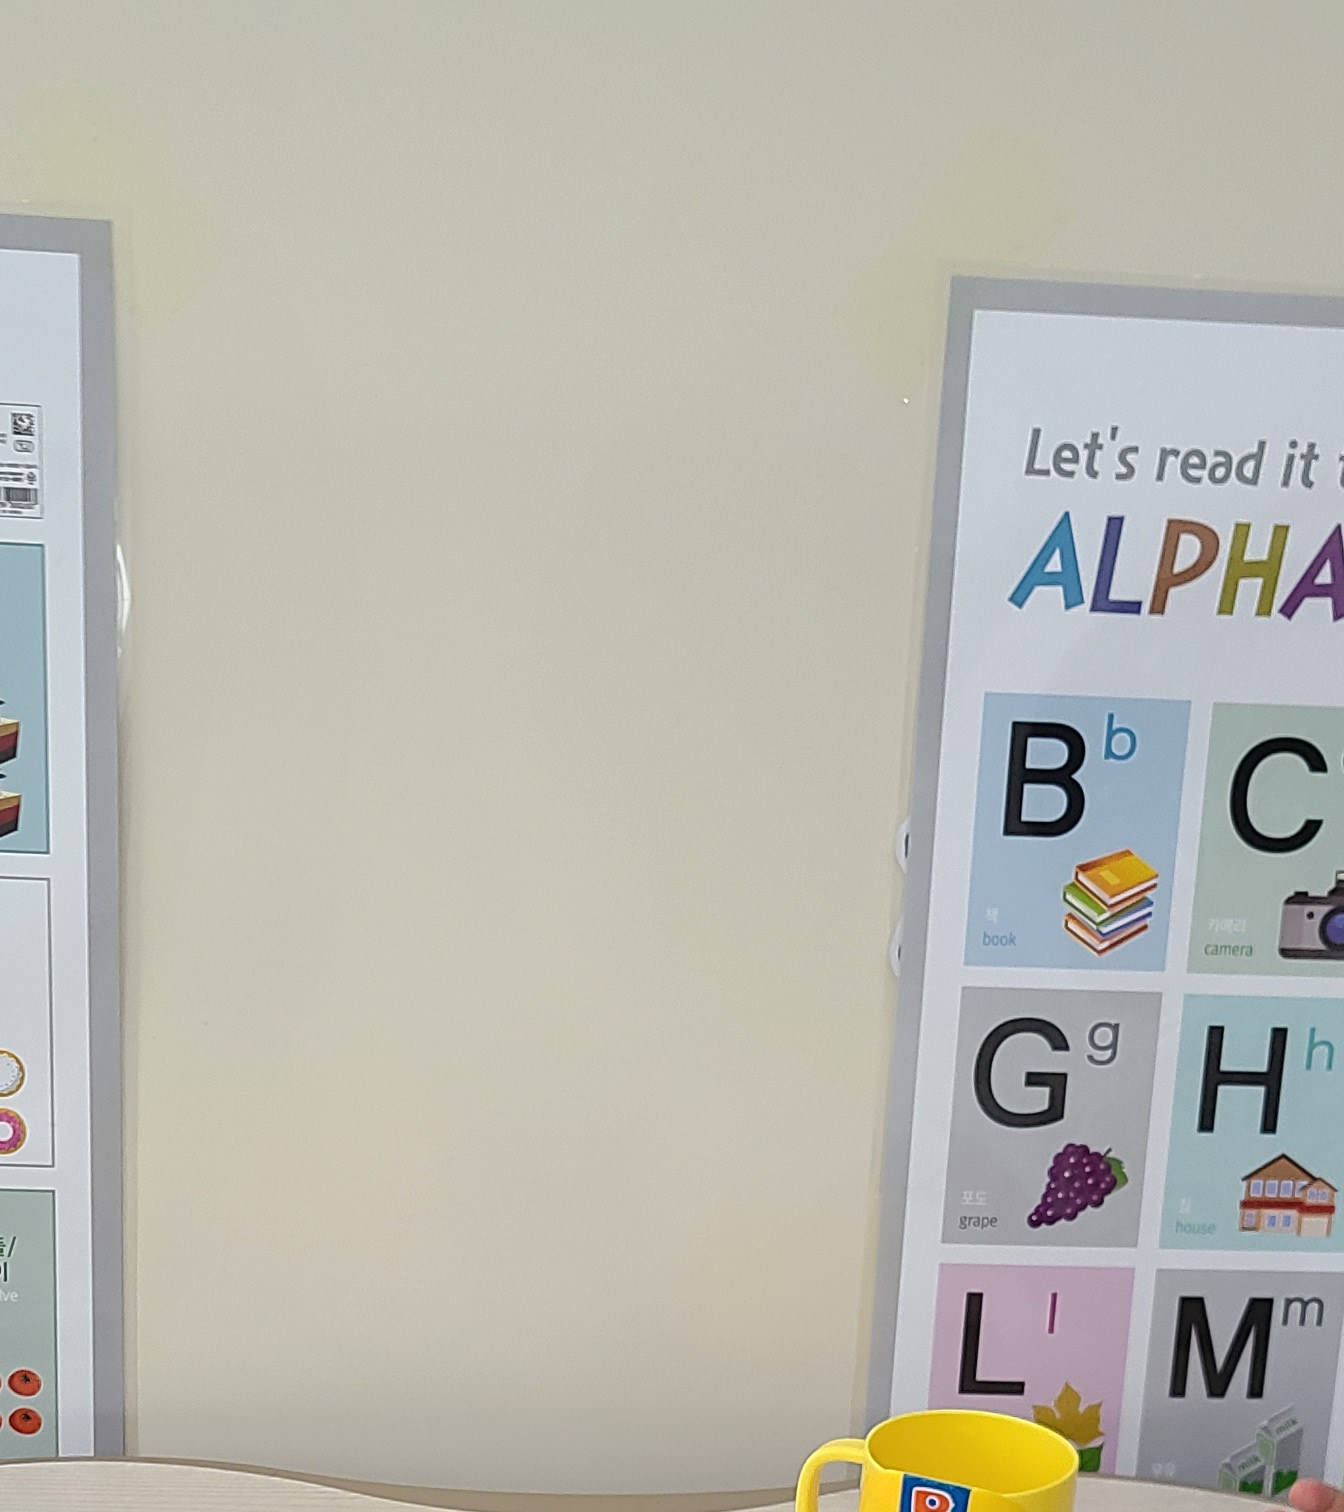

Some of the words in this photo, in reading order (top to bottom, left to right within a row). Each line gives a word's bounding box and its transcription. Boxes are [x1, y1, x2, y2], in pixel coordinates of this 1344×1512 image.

[1023, 425, 1140, 481] Let's
[1155, 440, 1266, 486] read
[1280, 440, 1320, 490] it
[1003, 720, 1086, 837] B
[1103, 713, 1138, 760] b
[1230, 737, 1328, 854] C
[982, 932, 1017, 947] book
[1204, 943, 1253, 957] camera
[974, 1017, 1070, 1128] G
[1087, 1021, 1120, 1066] g
[1197, 1026, 1288, 1134] H
[1305, 1027, 1335, 1071] h
[959, 1214, 998, 1230] grape
[958, 1292, 1025, 1395] L
[1169, 1296, 1275, 1399] M
[1281, 1297, 1324, 1327] m
